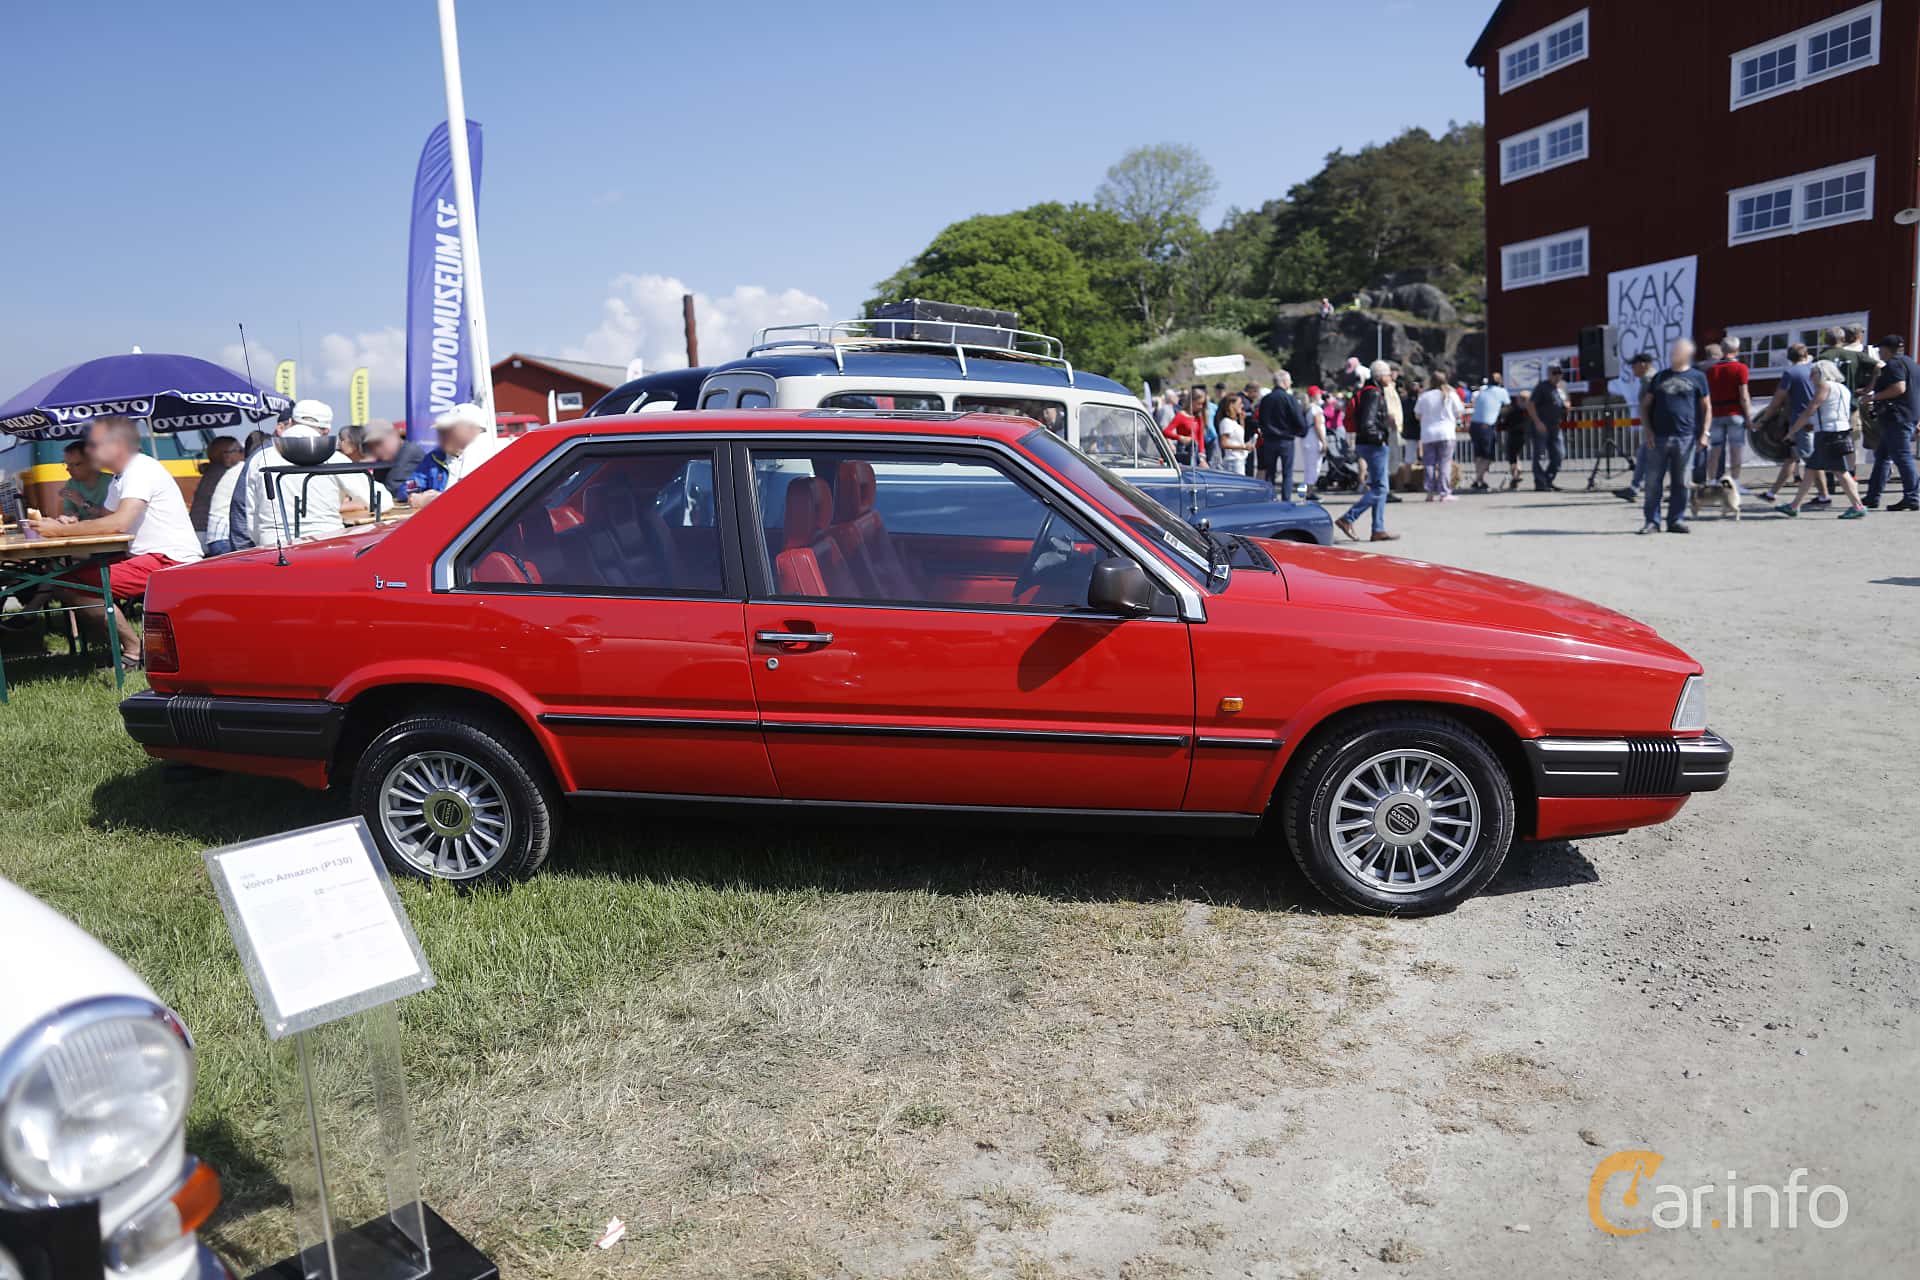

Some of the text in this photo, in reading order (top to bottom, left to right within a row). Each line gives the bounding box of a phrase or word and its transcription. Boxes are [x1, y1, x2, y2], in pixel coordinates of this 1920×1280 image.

[1617, 267, 1685, 315] KAK
[430, 232, 464, 414] VOLVOMUSEUM
[181, 392, 258, 404] VOLVO
[52, 400, 149, 421] VOLVO
[1391, 809, 1414, 829] VOLVO
[242, 877, 274, 890] Volvo
[276, 865, 319, 883] Amazon
